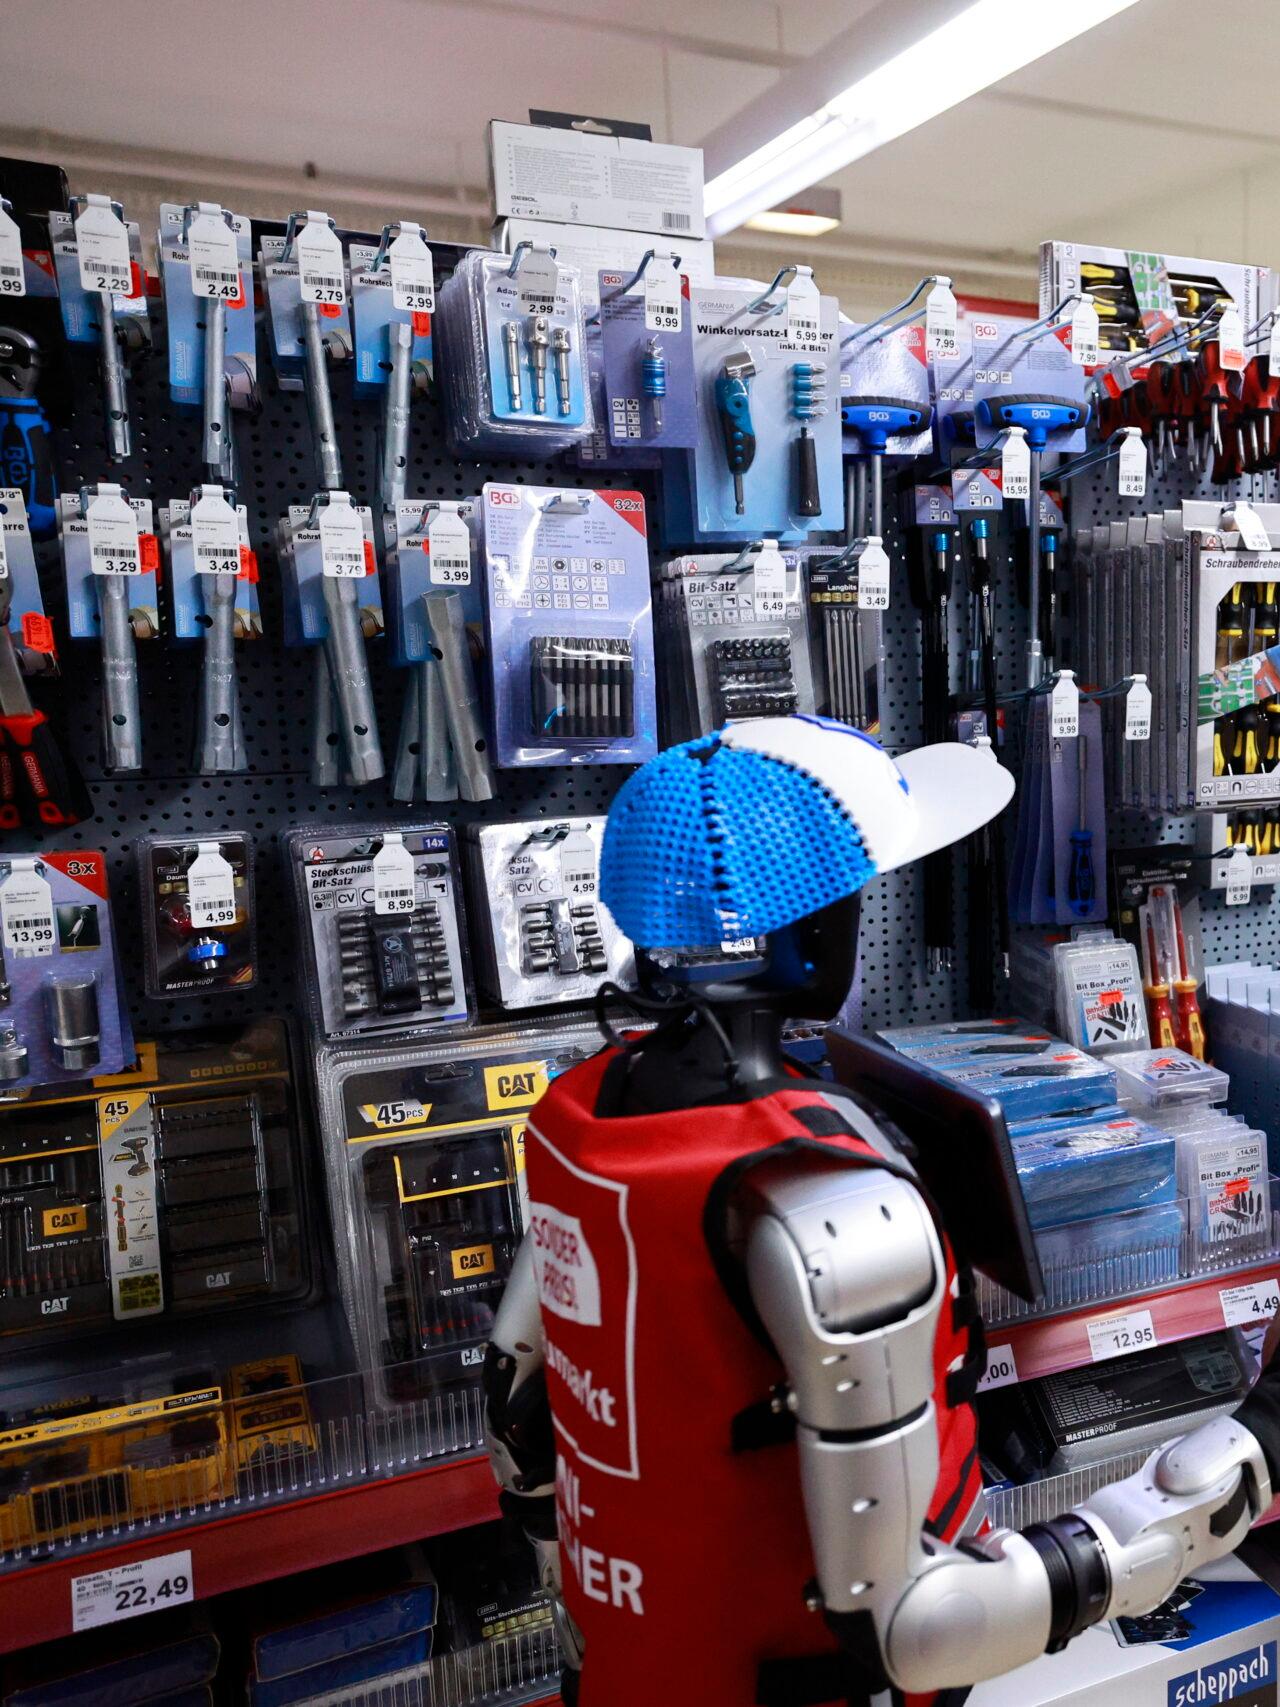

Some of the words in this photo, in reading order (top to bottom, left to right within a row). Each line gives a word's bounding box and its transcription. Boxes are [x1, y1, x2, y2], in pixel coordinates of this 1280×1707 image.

[0, 279, 22, 293] ,99
[97, 277, 130, 291] 2,29
[208, 284, 238, 297] 2,49
[315, 289, 343, 302] 2,79
[406, 296, 433, 309] 2,99
[529, 304, 553, 314] 2,99
[655, 316, 678, 328] 9,99
[796, 330, 817, 342] 5,99
[779, 343, 799, 351] inkl.
[809, 344, 827, 353] Bits
[935, 338, 955, 349] 7,99
[1079, 352, 1096, 363] 7,99
[976, 372, 986, 380] CV
[1005, 484, 1028, 494] 15,95
[1126, 484, 1143, 493] 8,49
[614, 498, 642, 511] 32x
[2, 523, 24, 531] arre
[106, 561, 137, 573] 3,29
[209, 560, 238, 571] 3,49
[335, 564, 363, 575] 3,79
[443, 571, 469, 581] 3,99
[688, 581, 736, 593] Bit-Satz
[827, 583, 857, 593] Langbits
[691, 599, 703, 608] CV
[762, 601, 783, 611] 6,49
[866, 596, 886, 606] 3,49
[1059, 724, 1077, 735] 9,99
[1132, 728, 1148, 737] 4,99
[1201, 784, 1213, 793] CV
[425, 838, 445, 848] 14x
[67, 861, 95, 876] 3x
[310, 864, 374, 878] Steckschlüs
[312, 877, 353, 889] Bit-Satz
[517, 883, 533, 893] CV
[572, 882, 595, 894] 4,99
[337, 893, 355, 903] CV
[387, 899, 414, 911] 8,99
[206, 910, 234, 923] 4,99
[11, 930, 53, 943] 13,99
[1076, 983, 1088, 991] Bit
[1090, 981, 1105, 989] Box
[497, 1072, 536, 1098] CAT
[104, 1100, 129, 1117] 45
[377, 1102, 405, 1125] 45
[406, 1109, 424, 1119] PCS
[1201, 1173, 1213, 1181] Bit
[1215, 1171, 1231, 1179] Box
[51, 1212, 79, 1228] CAT
[459, 1251, 486, 1270] CAT
[206, 1271, 231, 1288] CAT
[41, 1296, 69, 1315] CAT
[1252, 1296, 1280, 1314] 4,49
[1113, 1327, 1153, 1349] 12,95
[0, 1430, 38, 1444] ALT
[1065, 1422, 1118, 1443] MASTERPROOF
[115, 1575, 189, 1612] 22,49
[1175, 1644, 1269, 1707] scheppach
